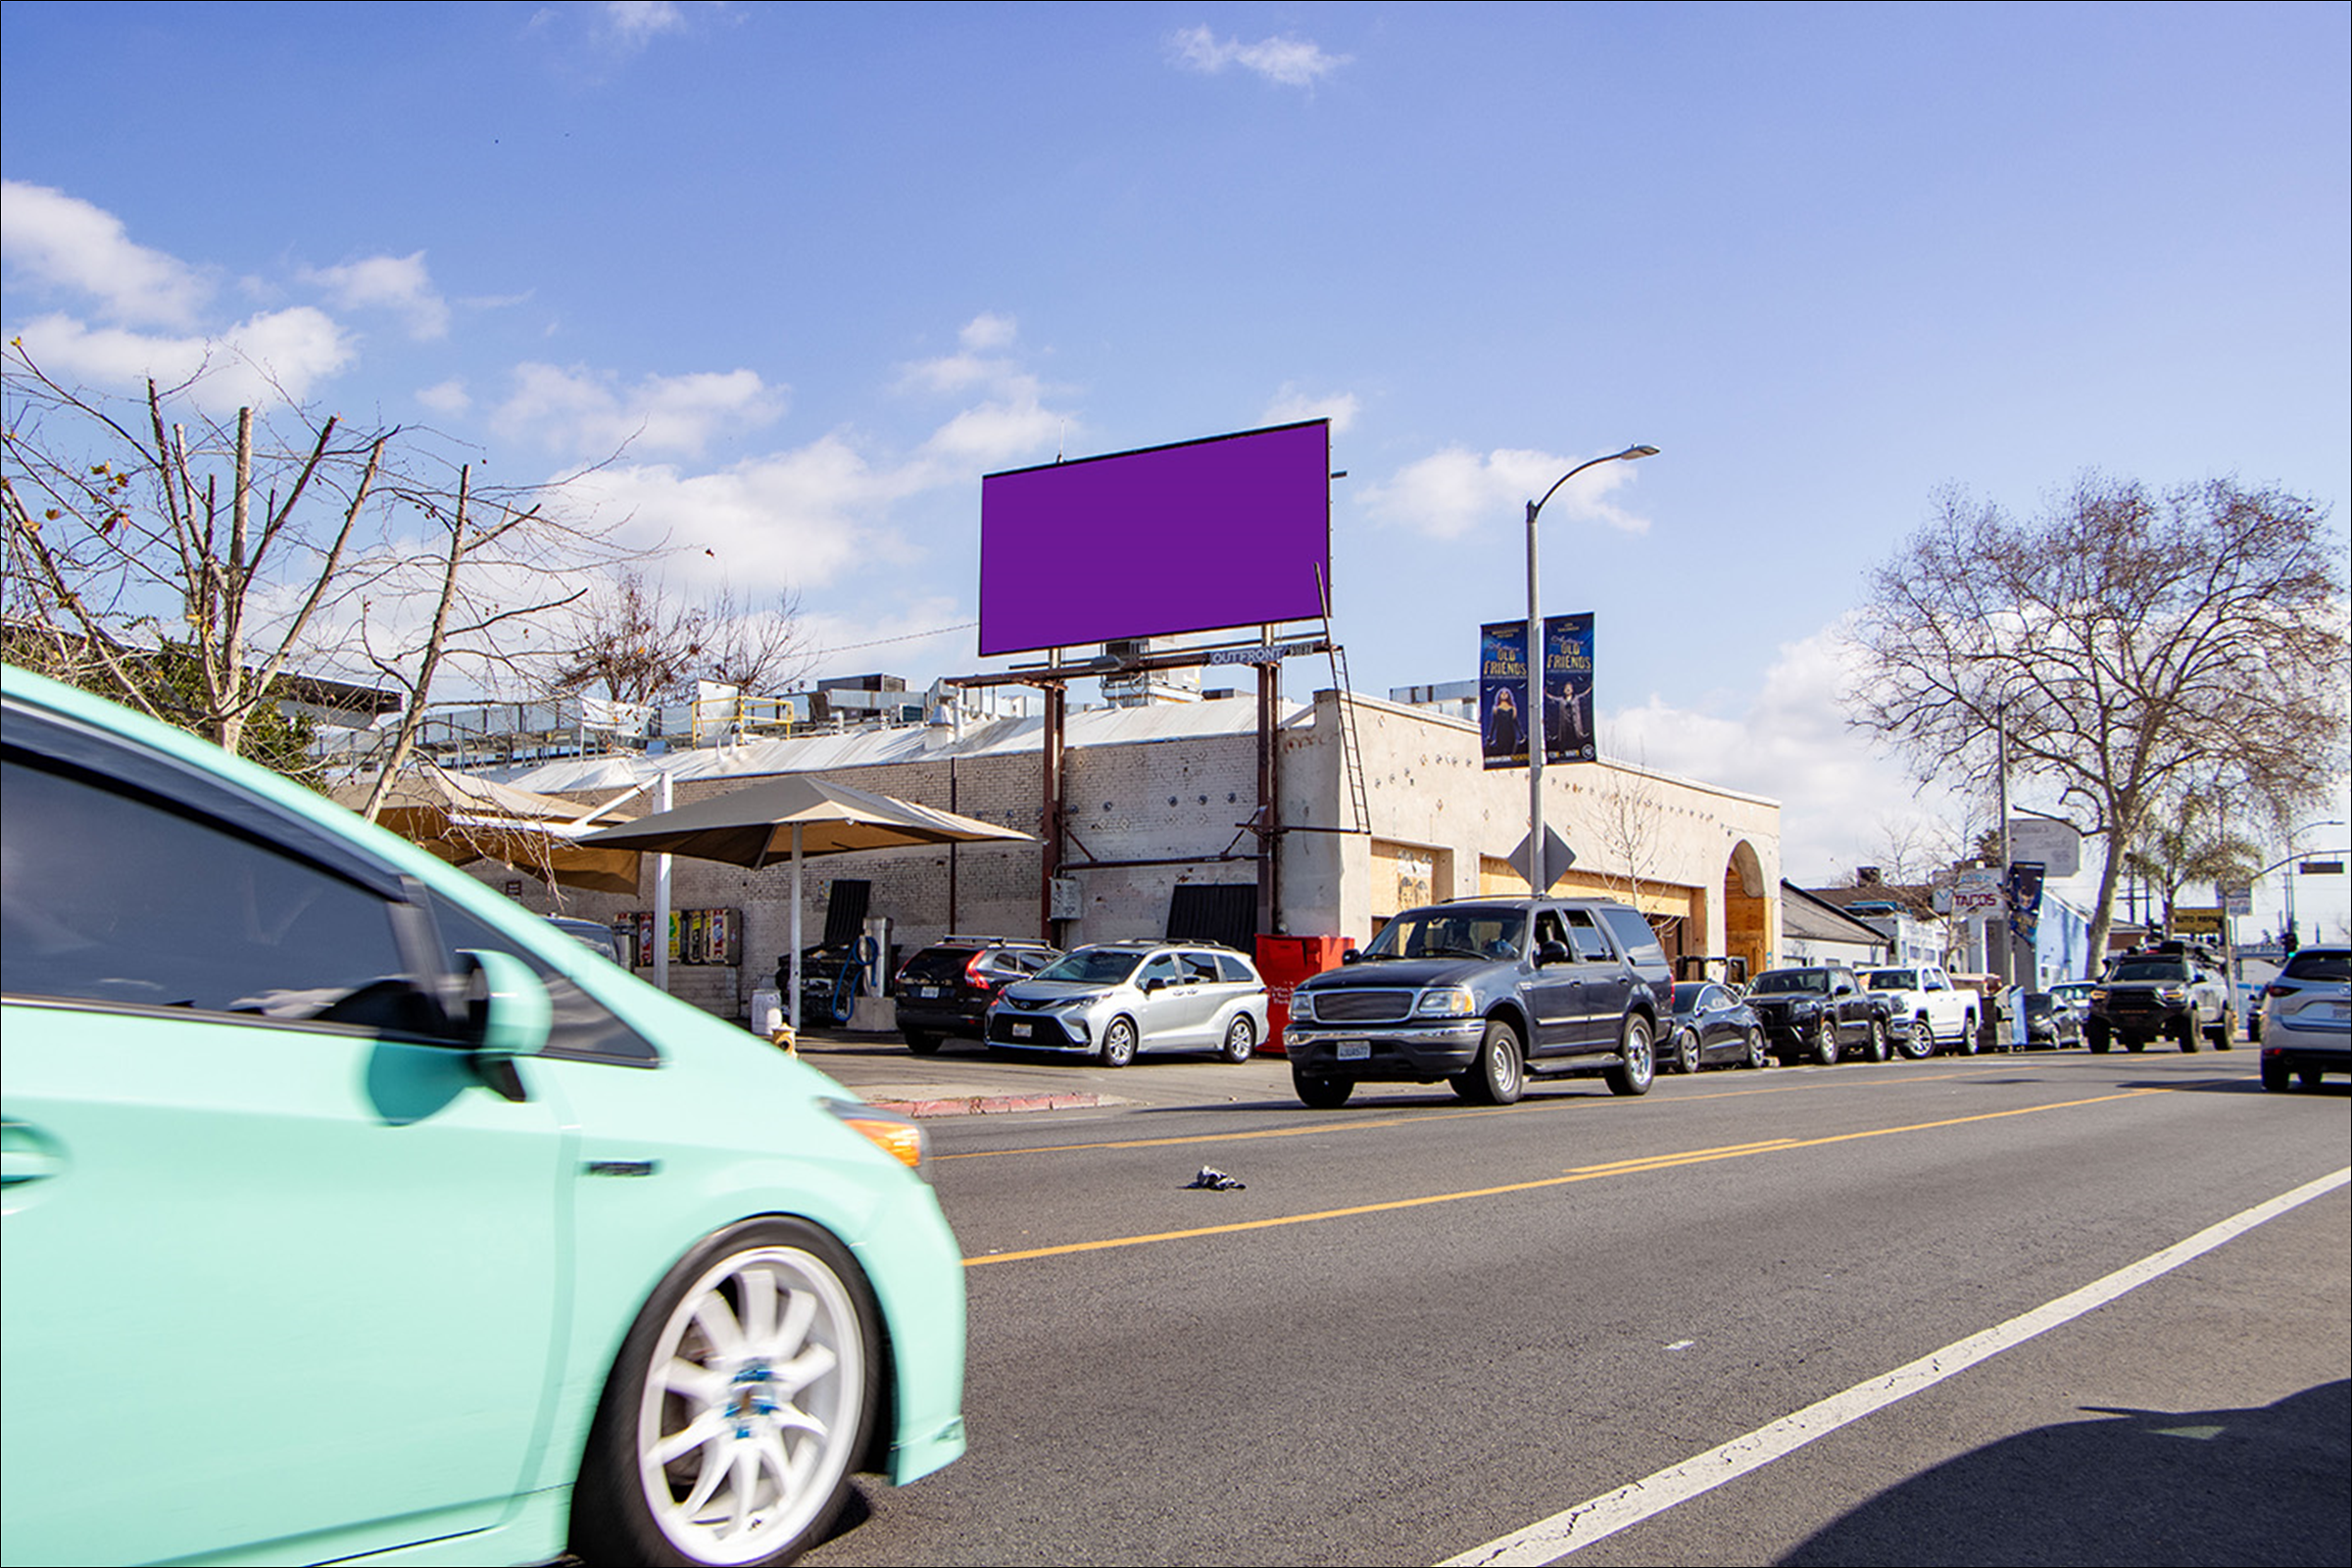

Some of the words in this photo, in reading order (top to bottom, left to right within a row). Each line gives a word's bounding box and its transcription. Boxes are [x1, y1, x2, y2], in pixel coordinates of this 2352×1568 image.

[1496, 648, 1516, 662] OLD
[1560, 642, 1580, 656] OLD
[1484, 661, 1527, 676] FRIENDS
[1546, 655, 1592, 669] FRIENDS
[1955, 893, 1996, 907] TACOS
